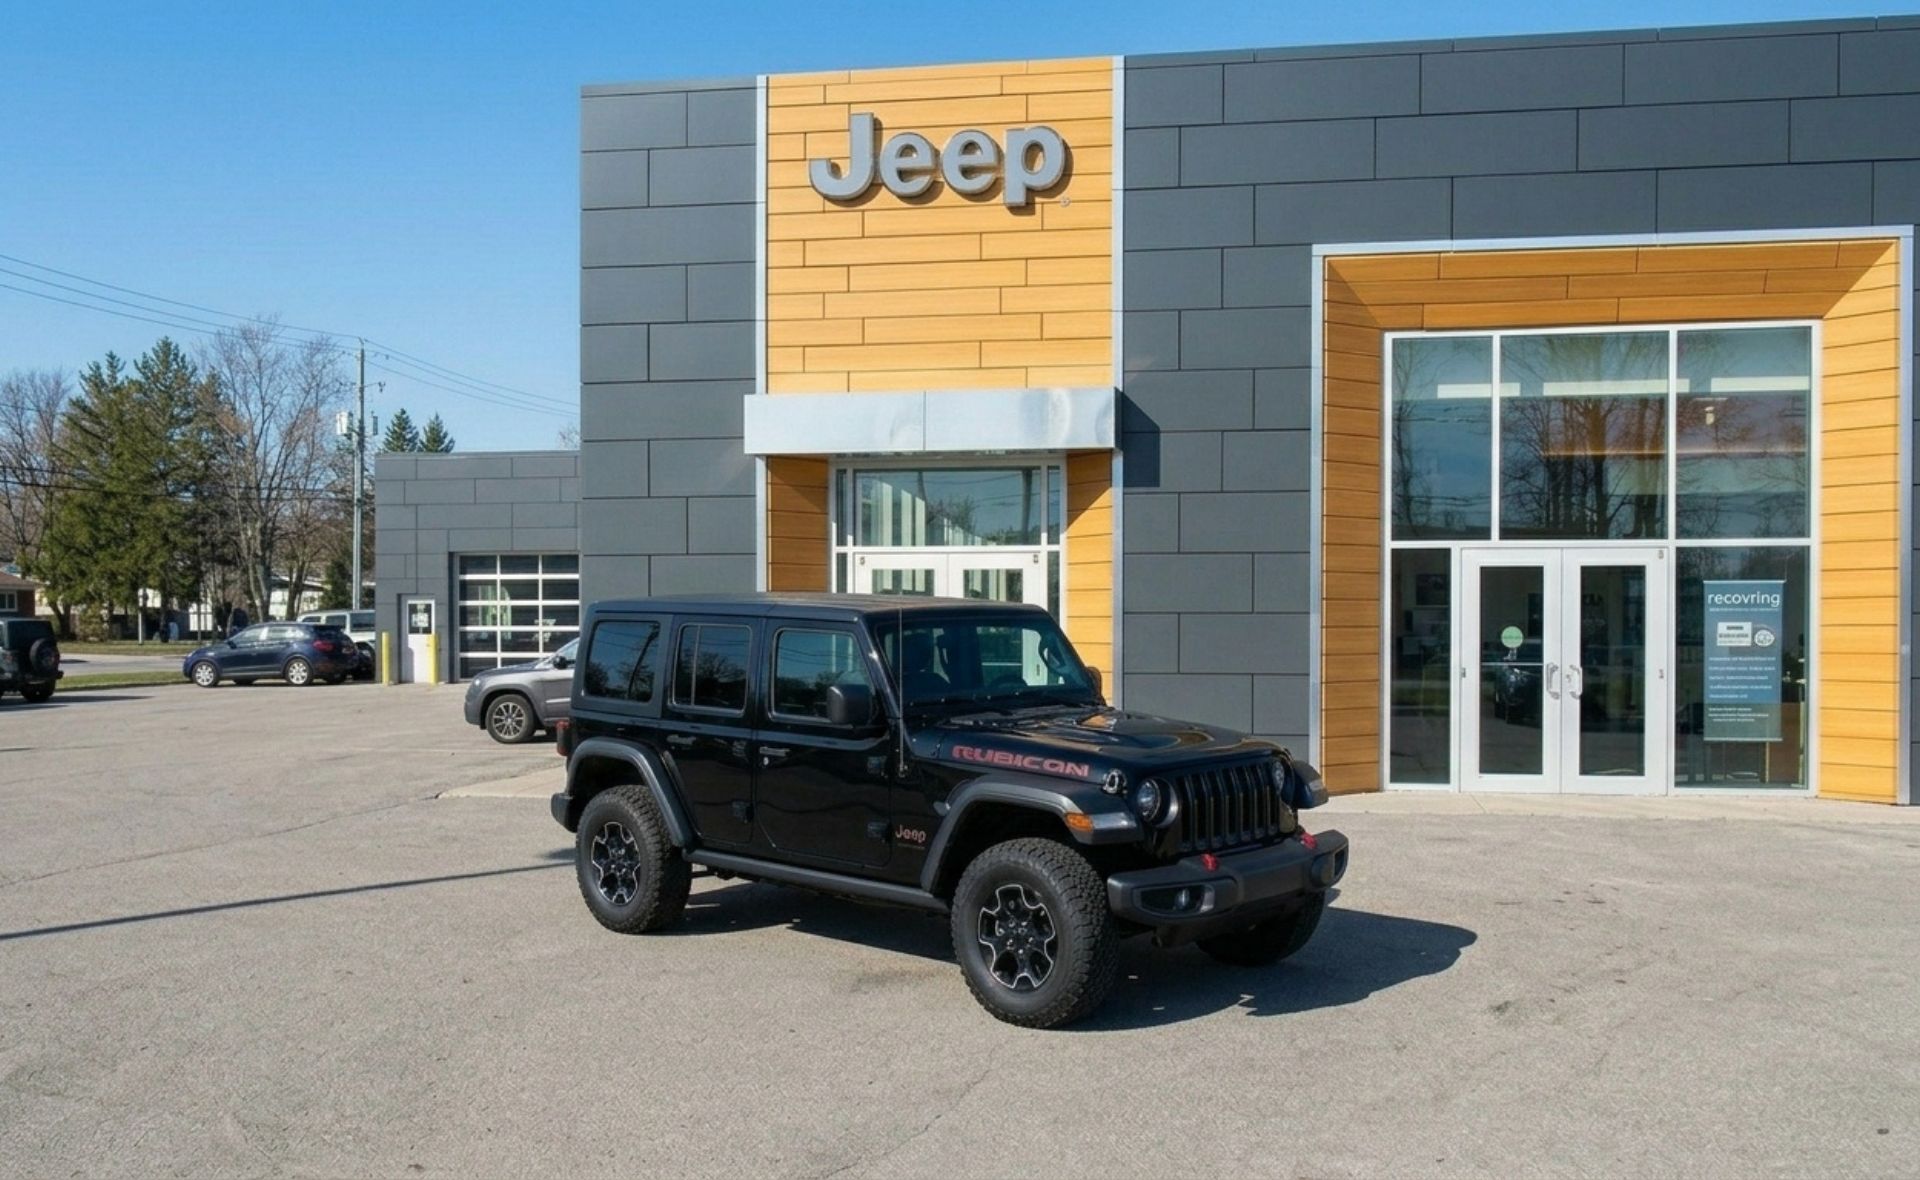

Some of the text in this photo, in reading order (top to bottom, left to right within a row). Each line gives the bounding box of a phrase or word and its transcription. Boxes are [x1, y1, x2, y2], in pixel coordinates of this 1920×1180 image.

[809, 112, 1067, 207] Jeep
[1707, 591, 1781, 607] recovring
[951, 745, 1090, 777] RUBICON
[895, 824, 927, 843] Jeep
